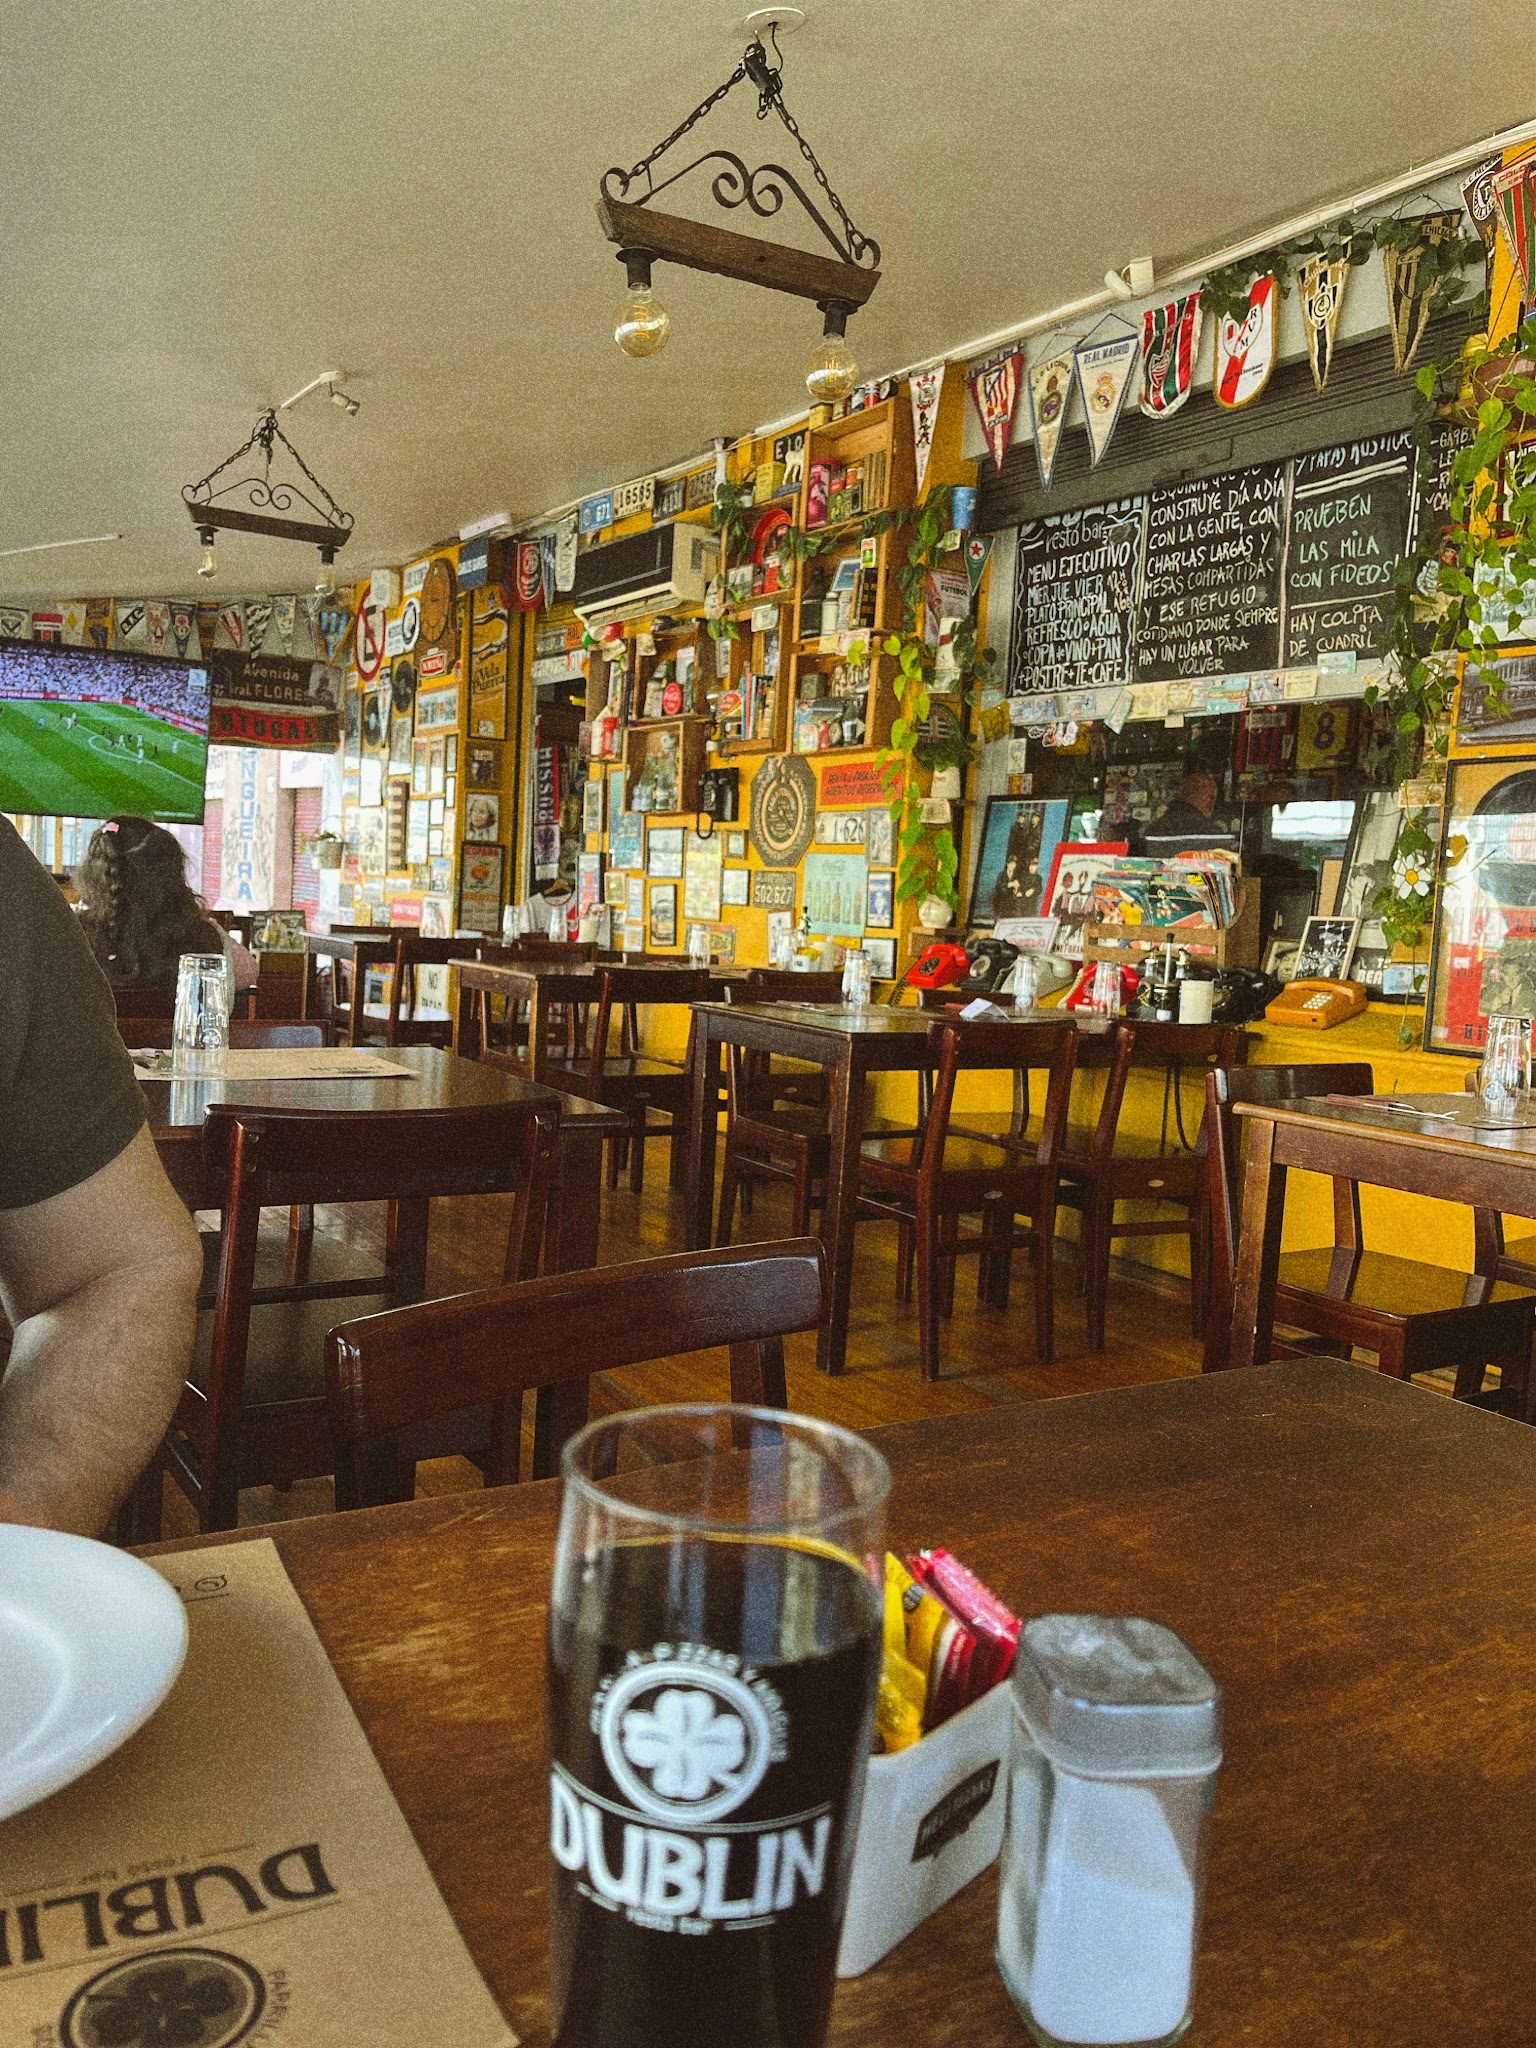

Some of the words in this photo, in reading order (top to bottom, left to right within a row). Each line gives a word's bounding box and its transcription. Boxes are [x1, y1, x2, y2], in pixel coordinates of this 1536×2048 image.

[1084, 350, 1101, 364] REAL
[1102, 343, 1130, 359] MADRID
[1149, 526, 1176, 550] CON
[1179, 524, 1195, 543] LA
[1248, 501, 1279, 528] CON
[1150, 492, 1221, 527] CONSTRUYE
[1294, 493, 1372, 533] PRUEBEN
[1027, 562, 1056, 586] MENU
[1059, 541, 1131, 578] EJECUTIVO
[1147, 546, 1207, 577] CHARLAS
[1210, 535, 1254, 563] LARGAS
[1261, 531, 1271, 554] Y
[1300, 540, 1329, 564] LAS
[1144, 576, 1184, 600] MESAS
[1290, 569, 1322, 589] CON
[1025, 601, 1057, 626] PLATO
[1057, 590, 1111, 620] PRINCIPAL
[1144, 607, 1153, 631] Y
[1159, 600, 1185, 623] ESE
[1190, 584, 1257, 616] REFUGIO
[1291, 611, 1317, 634] HAY
[1024, 617, 1083, 647] REFRESCO
[1089, 613, 1122, 639] AGUA
[1136, 621, 1193, 643] COTIDIANO
[1196, 613, 1231, 635] DONDE
[1235, 606, 1279, 628] SIEMPRE
[1028, 645, 1056, 666] COPA
[1064, 636, 1091, 661] VINO
[1097, 636, 1122, 660] PAN
[1139, 647, 1158, 667] HAY
[1161, 644, 1176, 663] UN
[1178, 638, 1213, 660] LUGAR
[1215, 635, 1250, 656] PARA
[1289, 639, 1310, 658] DE
[1316, 625, 1378, 653] CUADRIL
[243, 663, 300, 681] Avenida
[1091, 659, 1123, 684] CAFE
[1178, 656, 1225, 676] VOLVER
[1313, 711, 1336, 750] 8
[552, 1774, 832, 1919] DUBLIN
